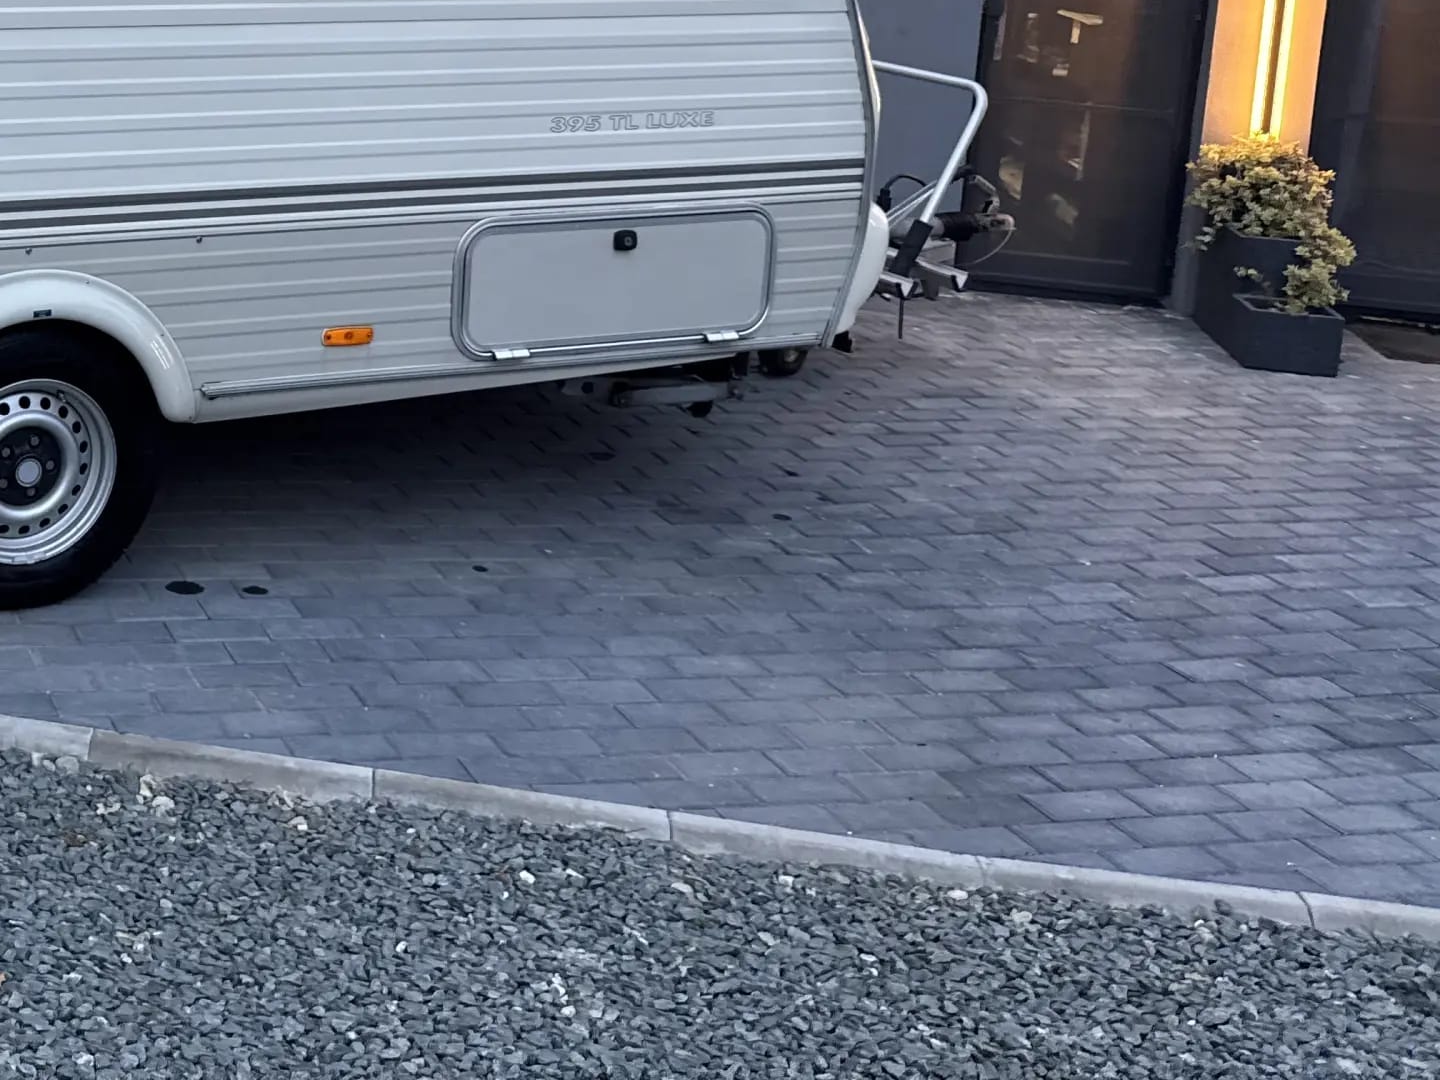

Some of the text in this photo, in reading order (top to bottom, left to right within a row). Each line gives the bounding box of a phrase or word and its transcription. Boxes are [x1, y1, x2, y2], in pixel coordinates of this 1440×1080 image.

[550, 110, 715, 134] 395 TL LUXE
